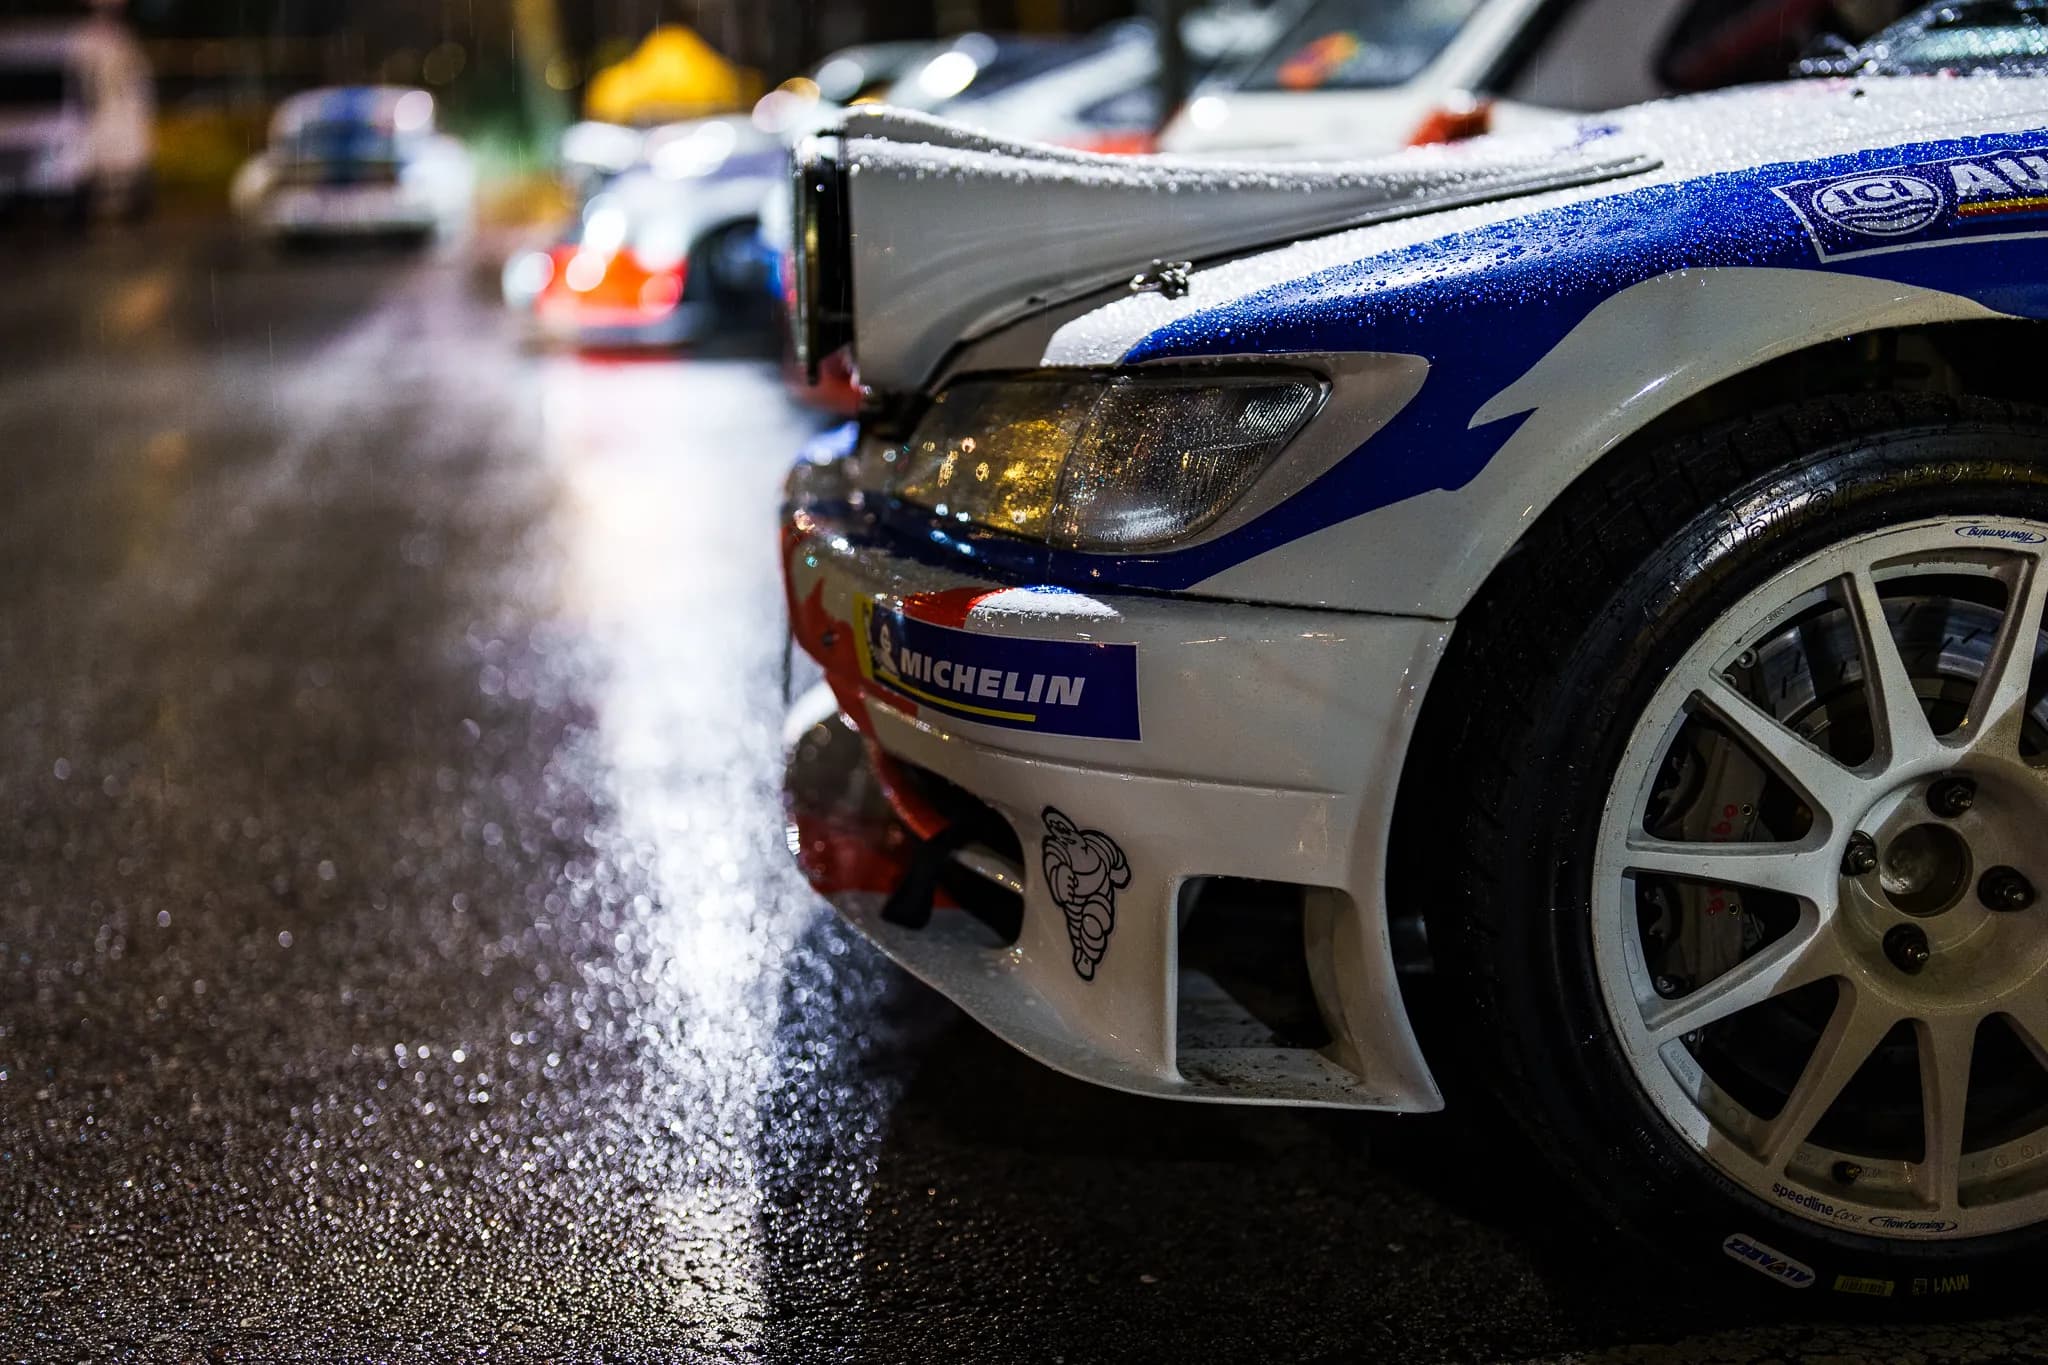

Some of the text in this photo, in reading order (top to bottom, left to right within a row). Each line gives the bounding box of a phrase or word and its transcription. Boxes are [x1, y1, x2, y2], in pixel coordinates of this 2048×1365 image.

[1832, 179, 1913, 207] ICI
[901, 647, 1085, 706] MICHELIN
[1772, 1182, 1834, 1216] speedline
